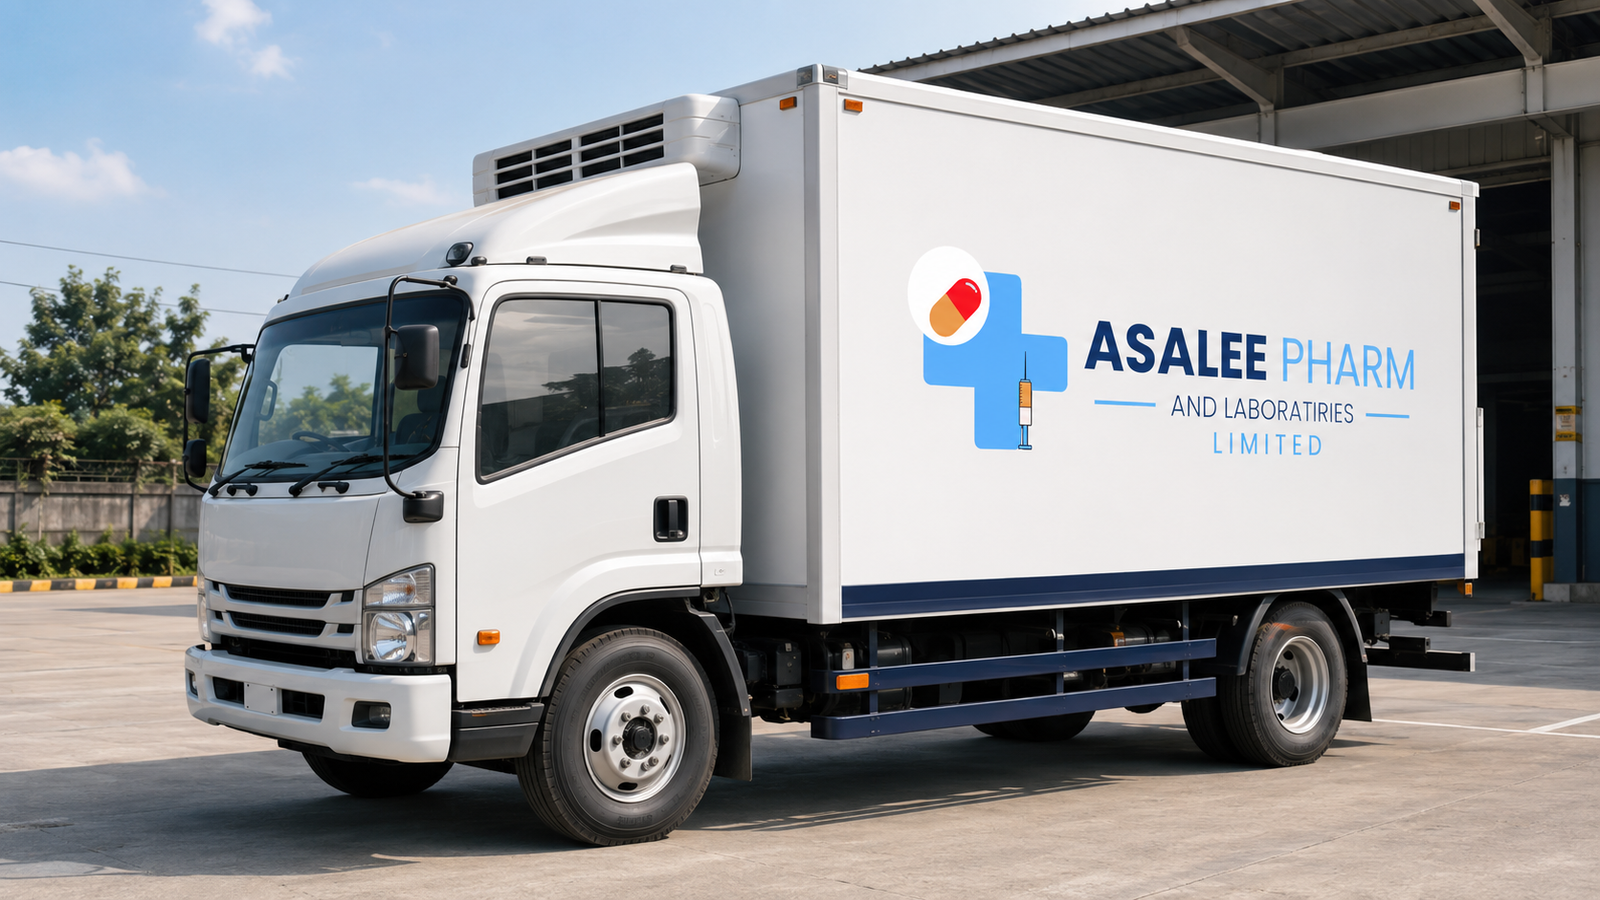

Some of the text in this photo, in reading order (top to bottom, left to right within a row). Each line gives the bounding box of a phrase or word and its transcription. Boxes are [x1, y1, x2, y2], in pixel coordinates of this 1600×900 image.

[1084, 320, 1415, 391] ASALEE PHARM
[1171, 395, 1354, 424] AND LABORATIRIES
[1213, 432, 1322, 457] LIMITED
